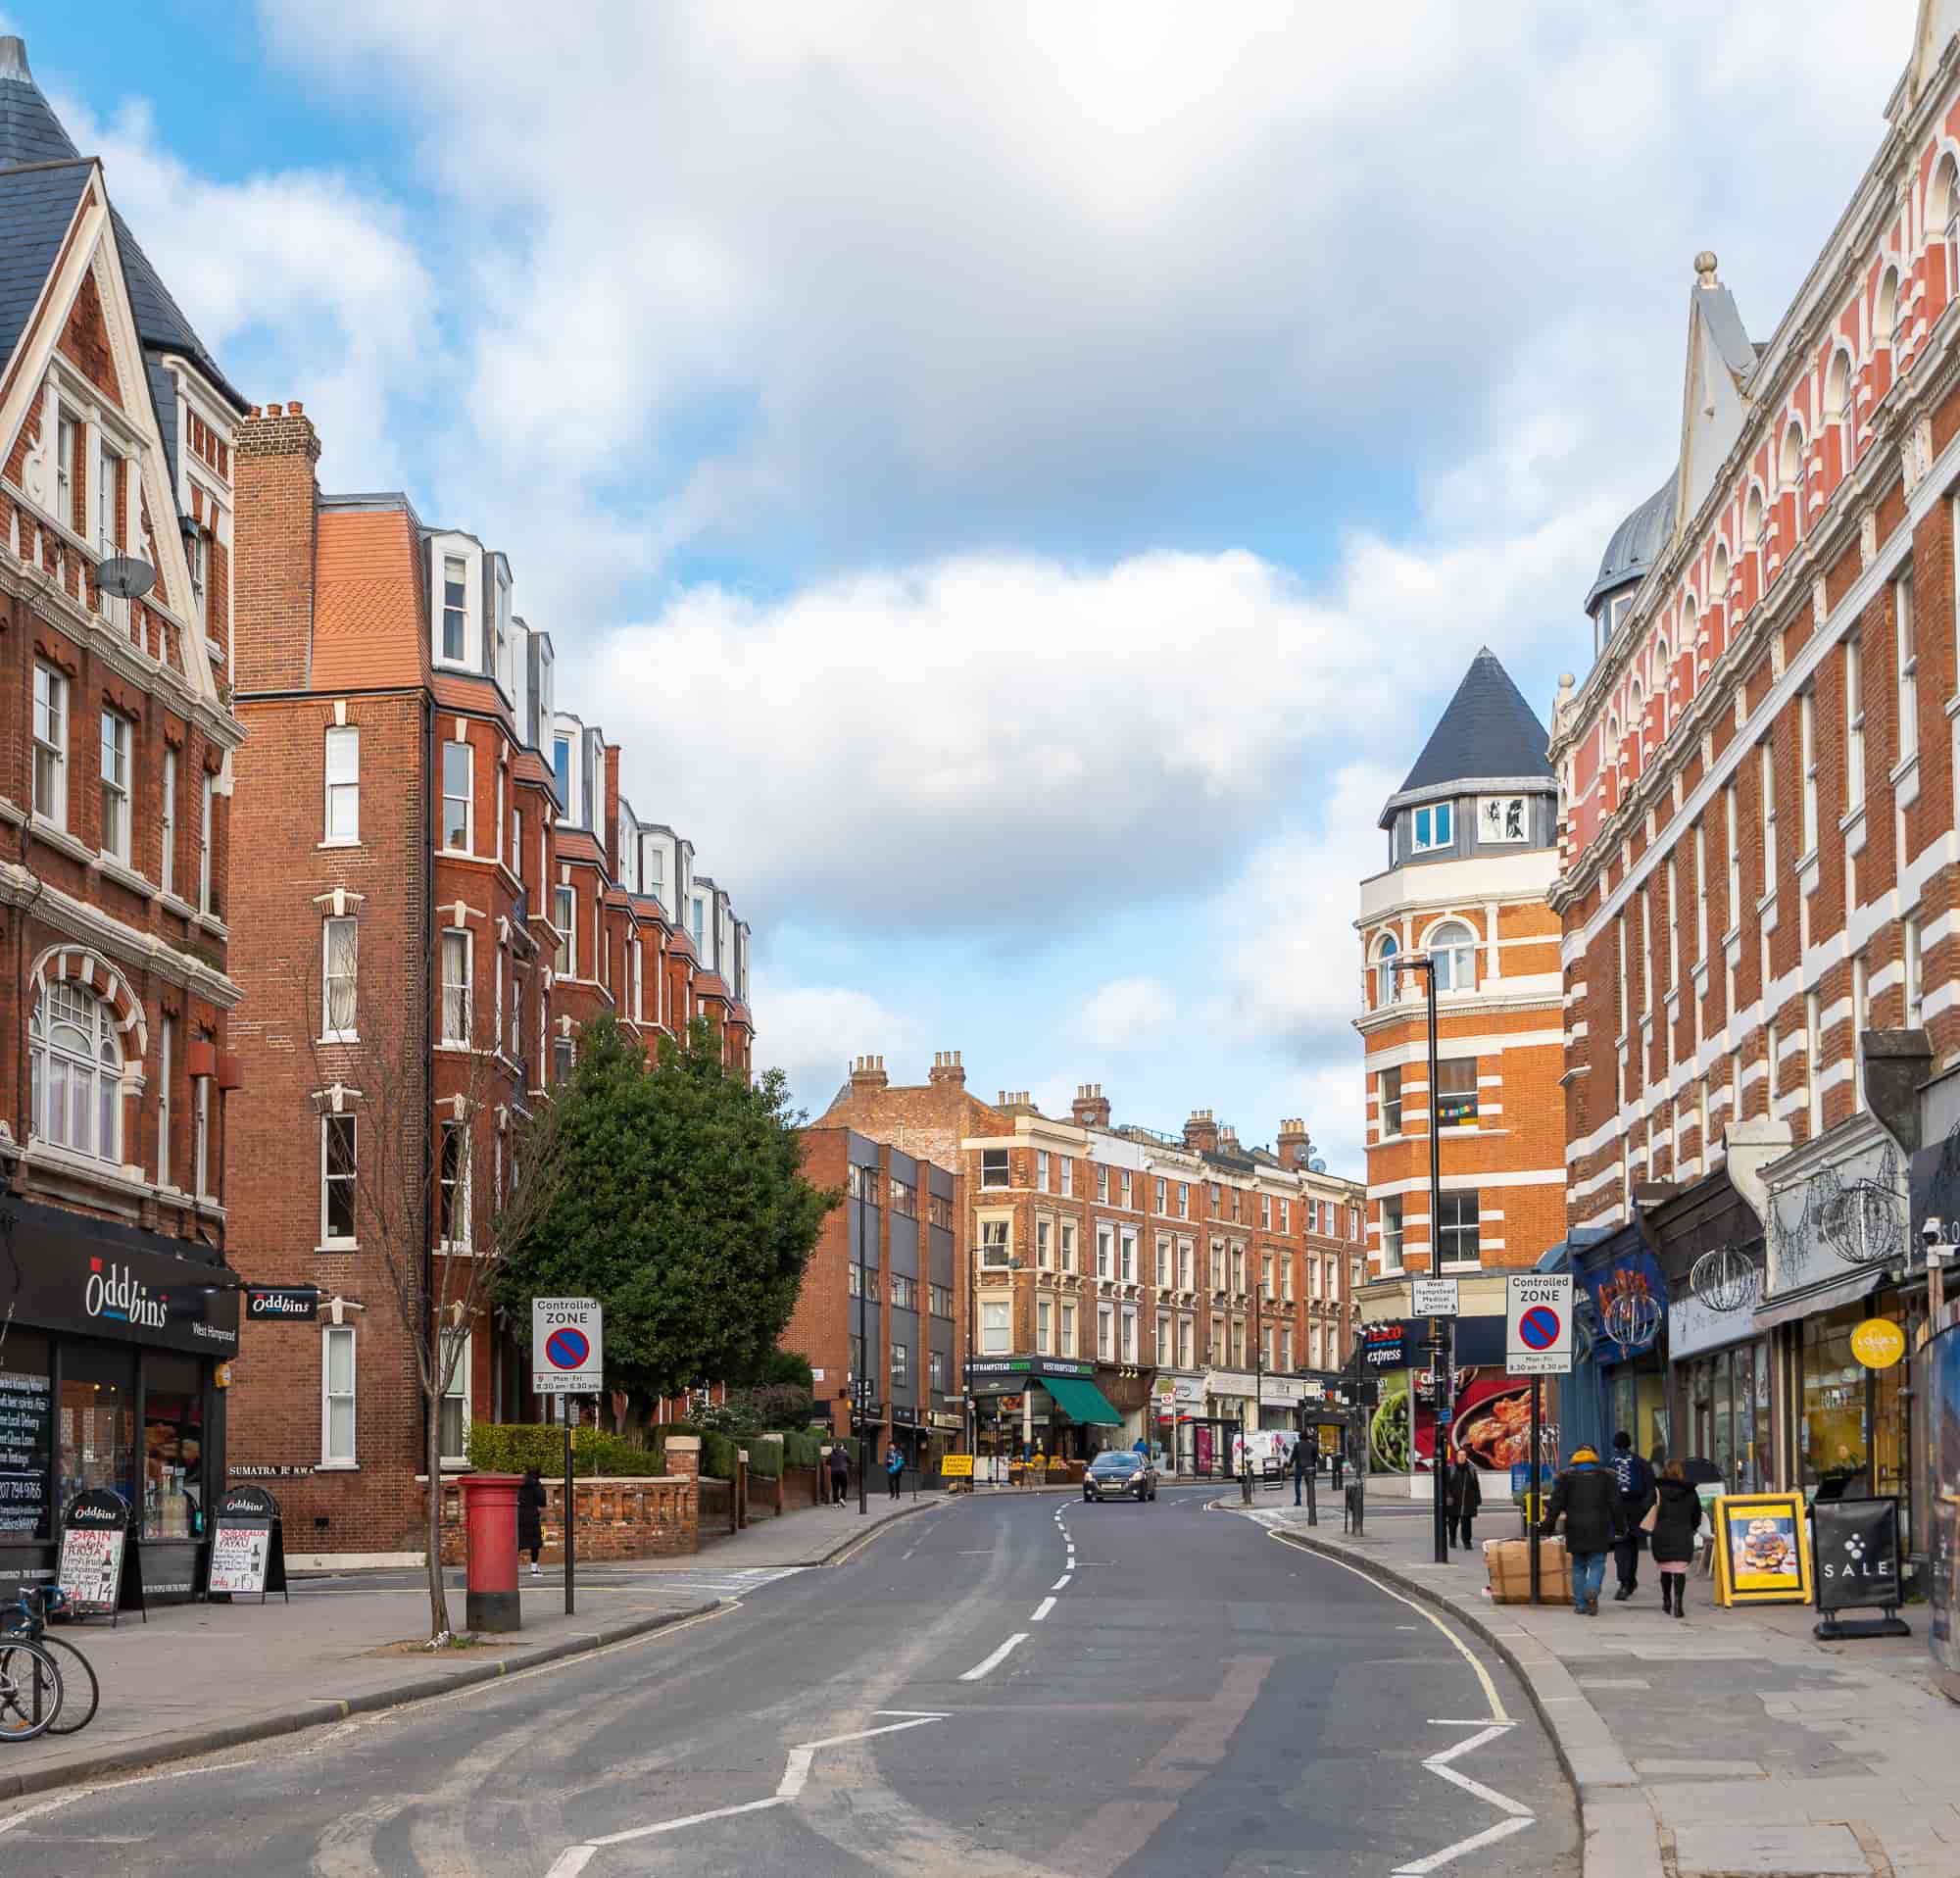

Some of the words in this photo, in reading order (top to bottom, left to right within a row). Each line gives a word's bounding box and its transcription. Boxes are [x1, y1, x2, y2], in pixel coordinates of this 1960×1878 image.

[1512, 1277, 1569, 1287] Controlled
[85, 1263, 168, 1328] Oddbins
[1521, 1290, 1560, 1302] ZONE
[253, 1293, 309, 1313] Oddbins
[537, 1301, 597, 1310] Controlled
[546, 1312, 588, 1324] ZONE
[1367, 1325, 1403, 1342] TESCO
[1367, 1349, 1401, 1365] express
[228, 1466, 276, 1475] SUMATRA
[227, 1499, 264, 1512] Oddbins
[75, 1506, 117, 1520] Oddbins
[72, 1530, 111, 1542] SPAIN
[1824, 1560, 1889, 1579] SALE
